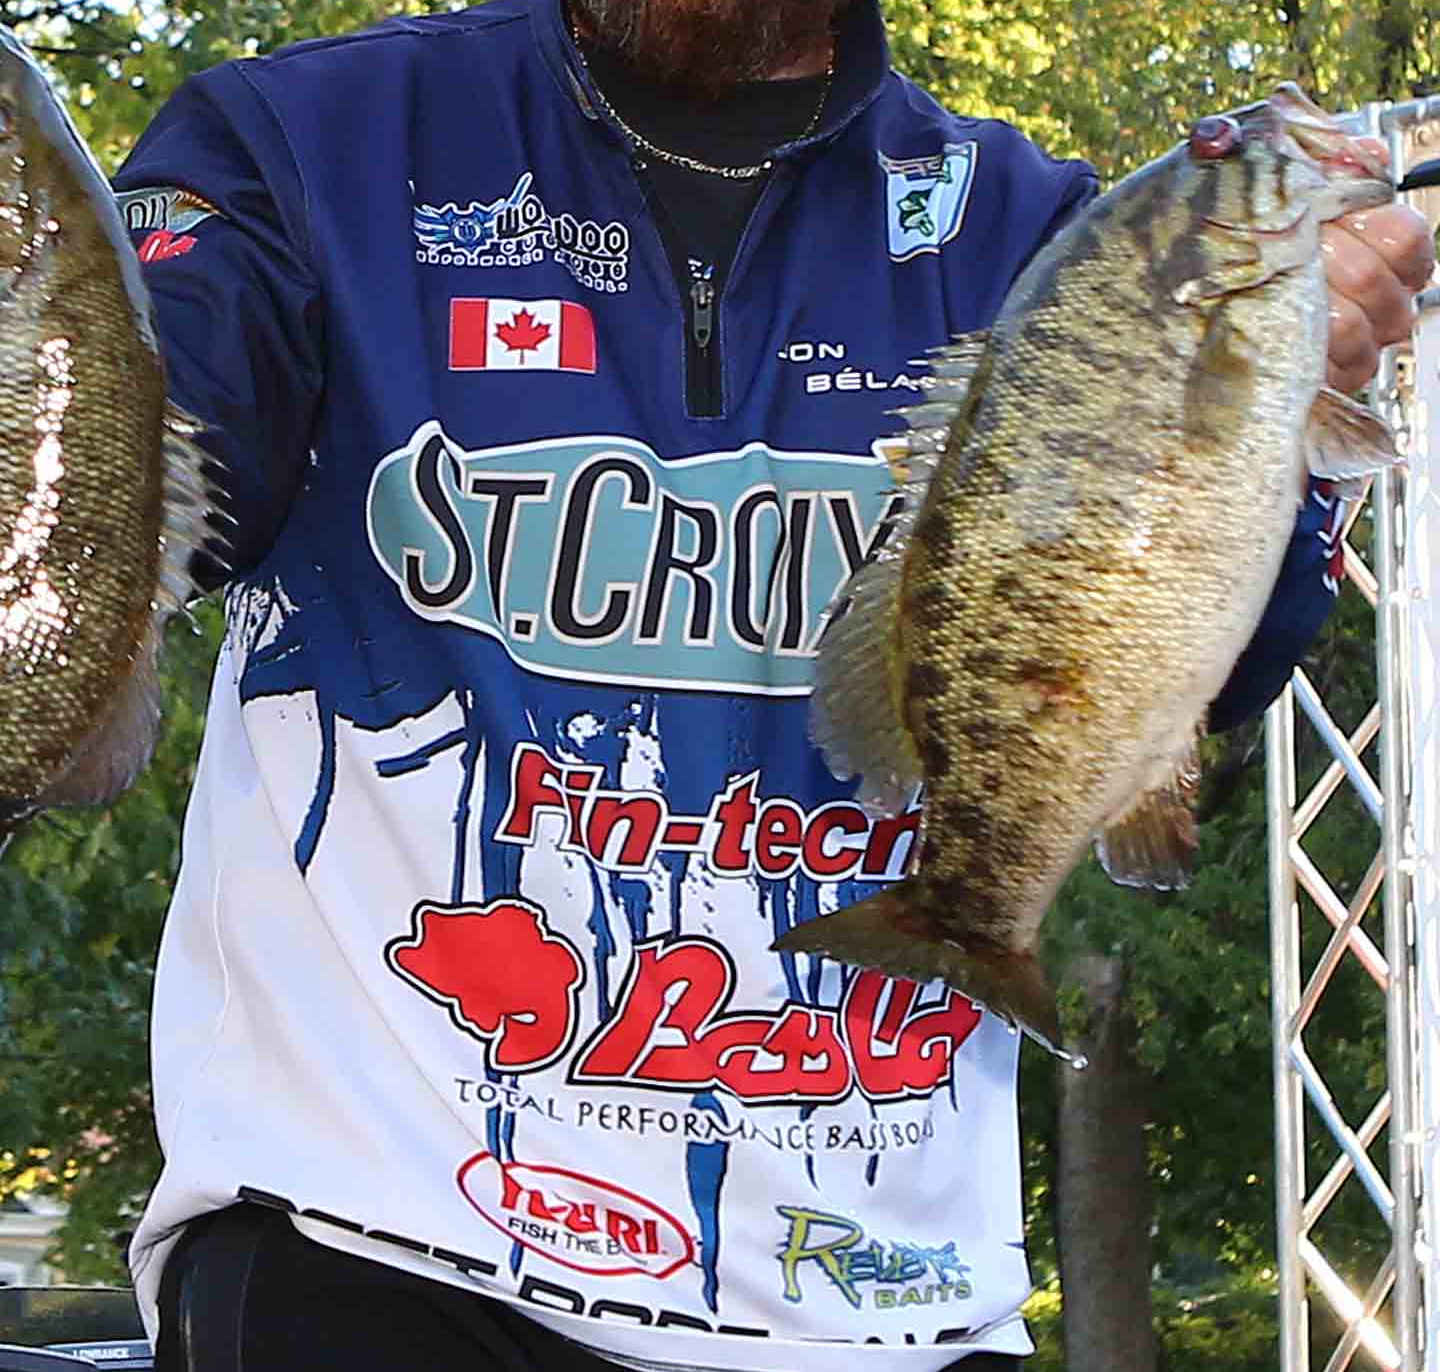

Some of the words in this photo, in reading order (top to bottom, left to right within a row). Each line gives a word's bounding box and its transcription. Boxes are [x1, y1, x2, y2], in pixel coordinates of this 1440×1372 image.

[778, 343, 845, 362] ON
[453, 1075, 564, 1123] TOTAL
[507, 1215, 558, 1245] FISH
[563, 1230, 602, 1256] THE
[873, 1279, 972, 1310] BAITS
